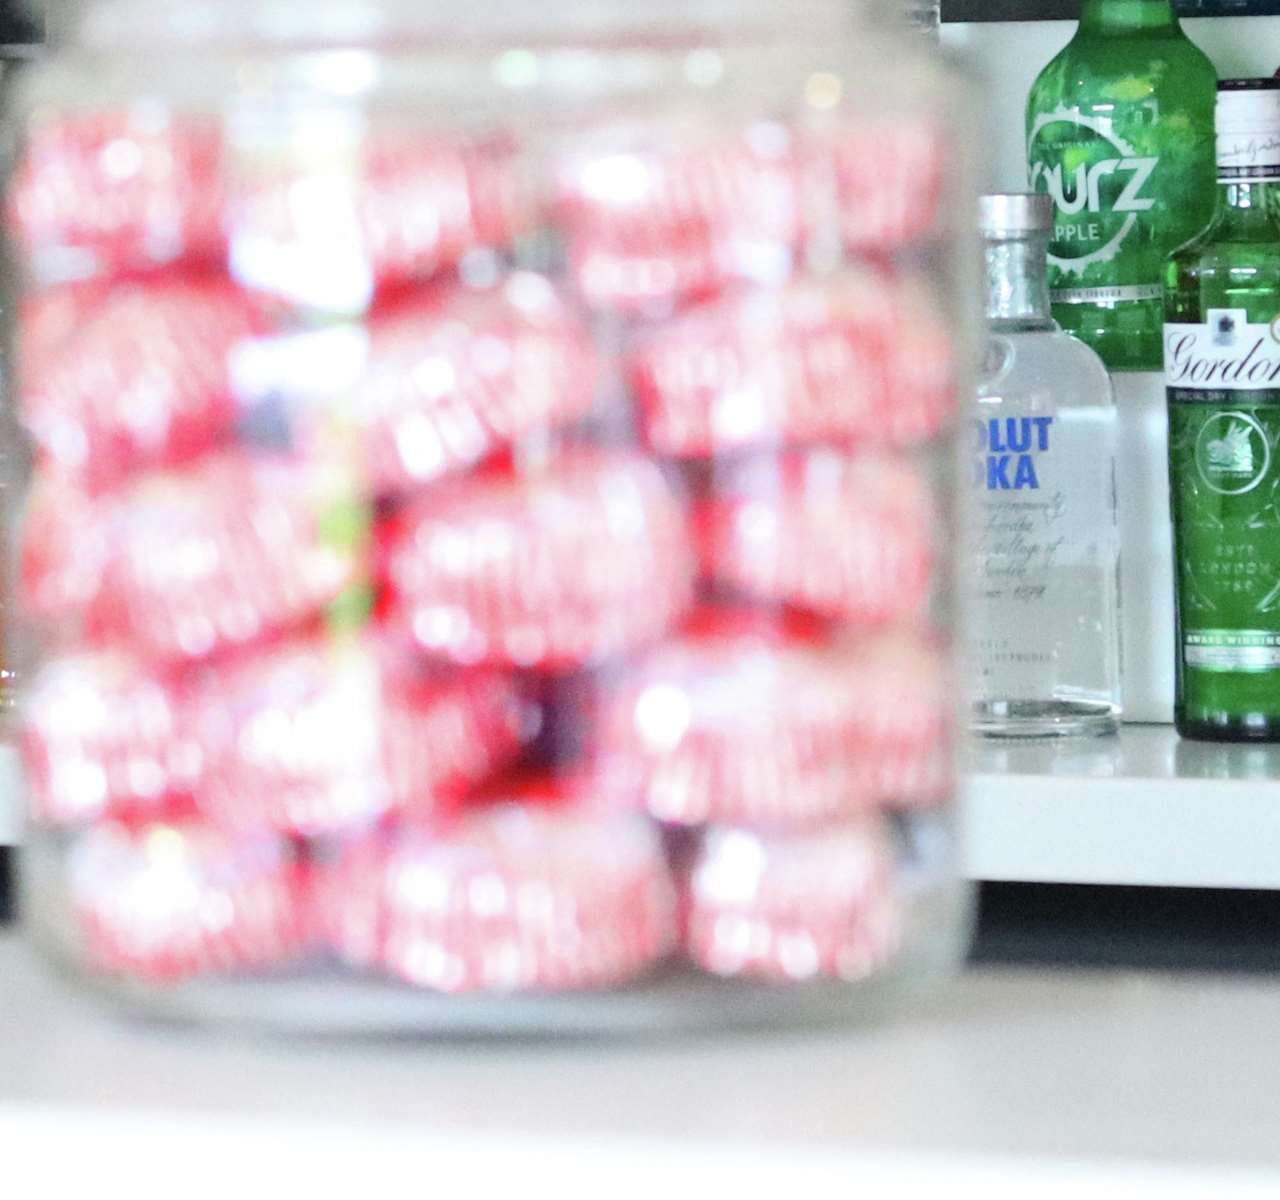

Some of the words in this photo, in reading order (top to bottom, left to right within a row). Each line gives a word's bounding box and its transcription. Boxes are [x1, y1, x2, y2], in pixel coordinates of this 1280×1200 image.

[1031, 157, 1159, 215] ourz
[1053, 224, 1100, 242] PPLE
[1168, 332, 1280, 382] Gordo
[977, 416, 1053, 452] OLUT
[977, 454, 1040, 490] DKA
